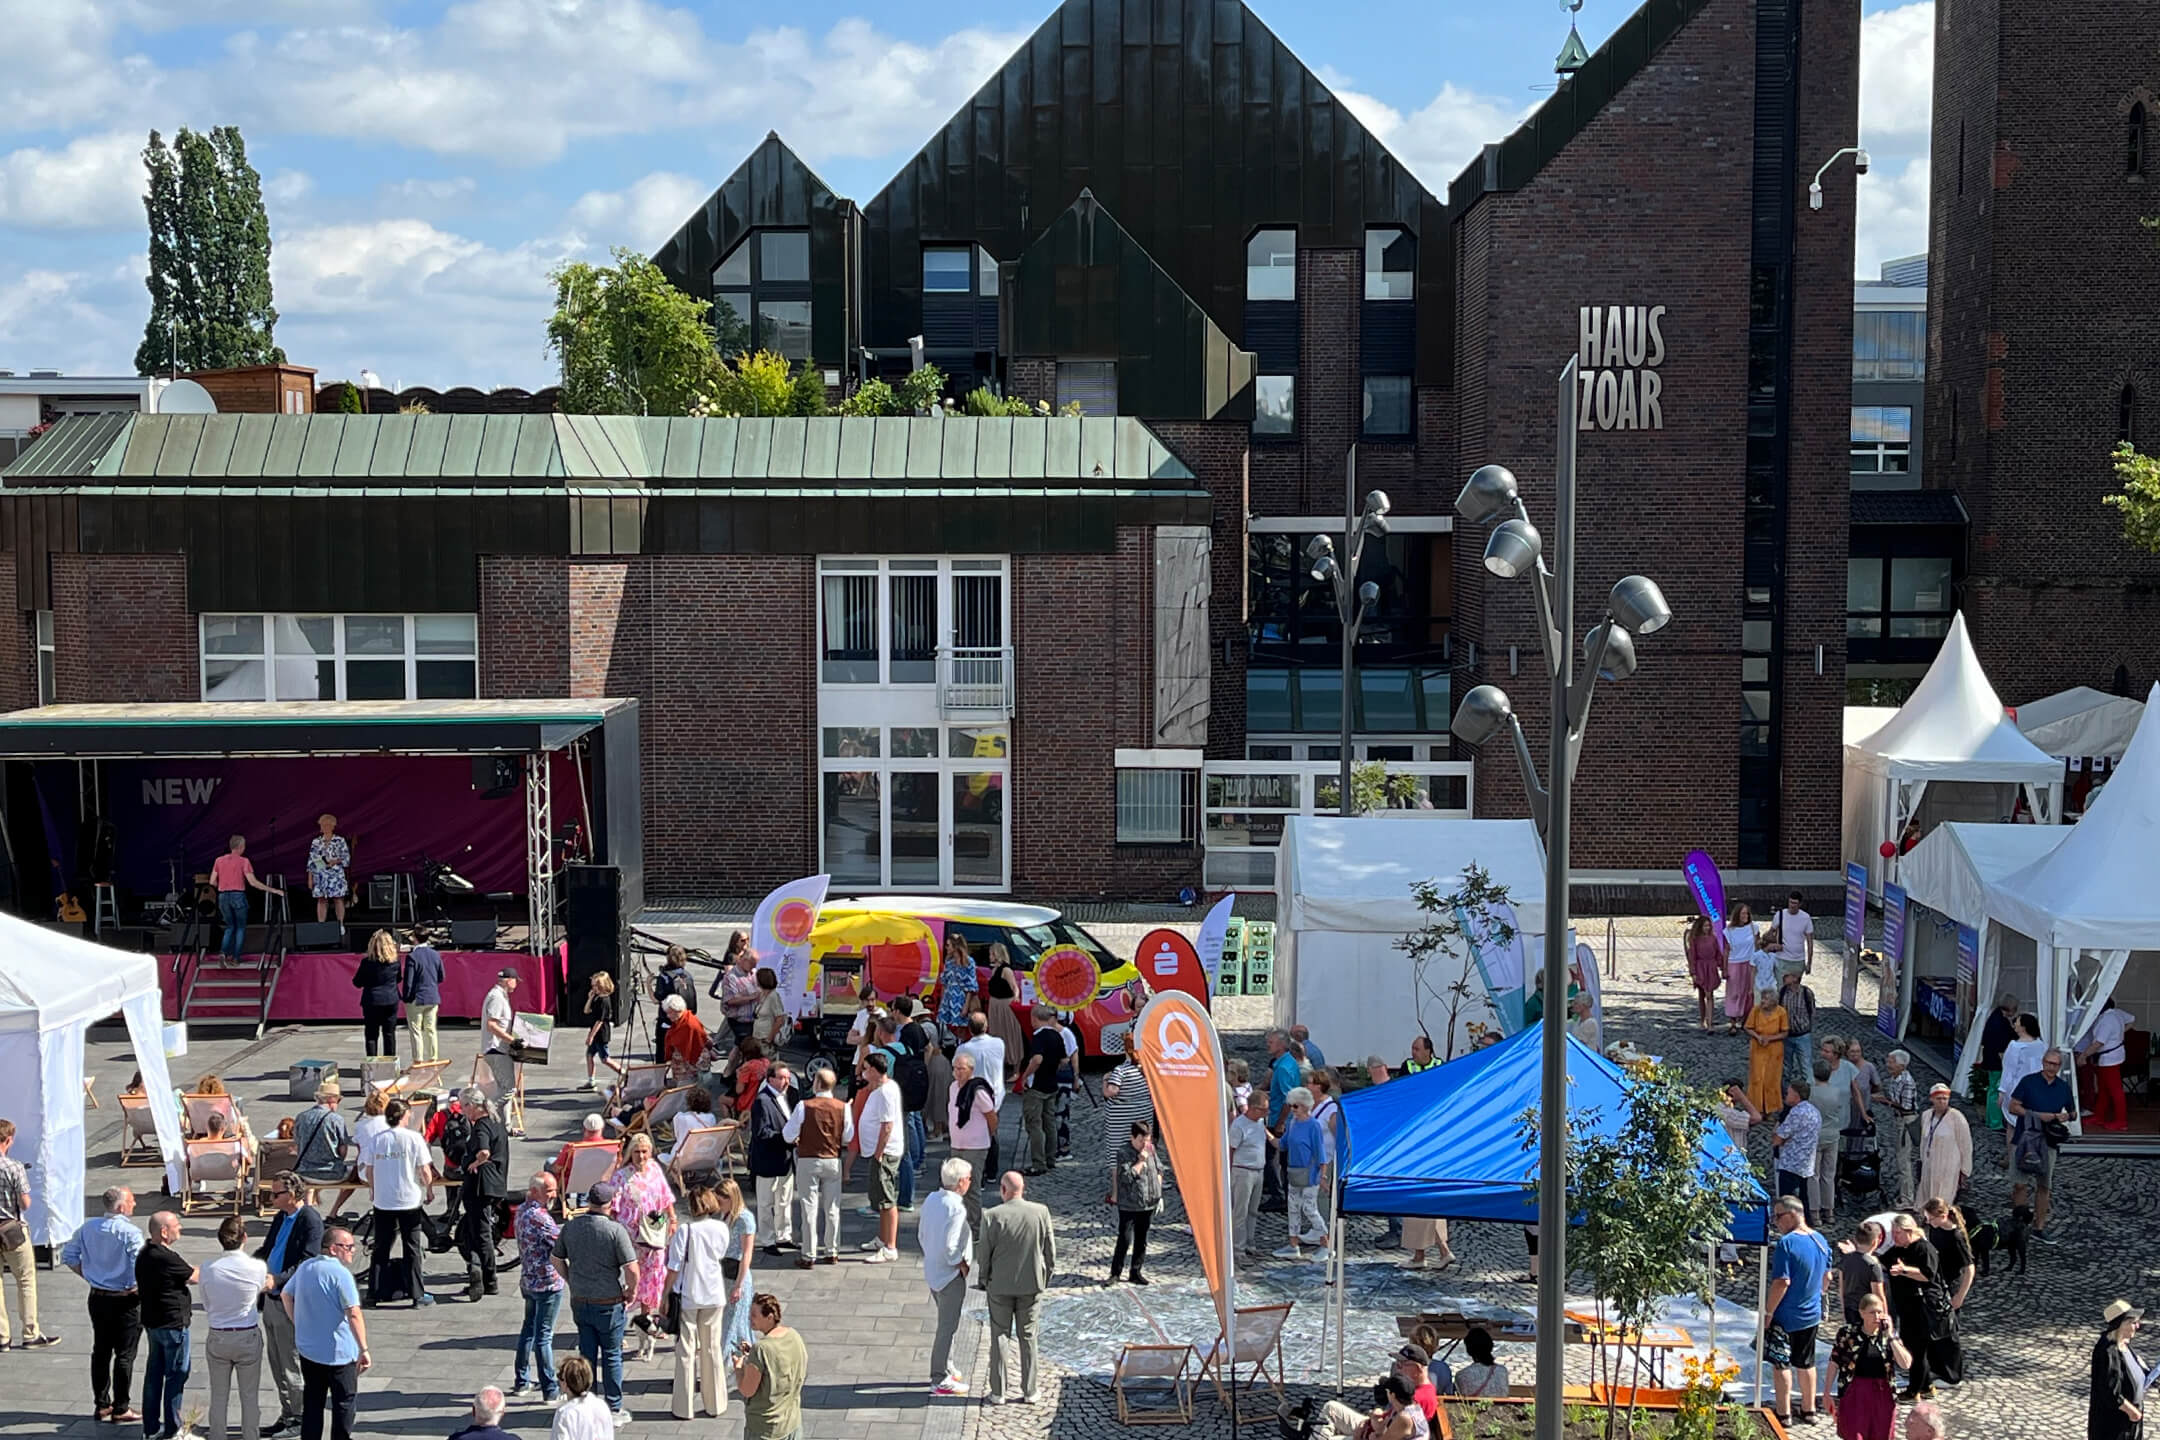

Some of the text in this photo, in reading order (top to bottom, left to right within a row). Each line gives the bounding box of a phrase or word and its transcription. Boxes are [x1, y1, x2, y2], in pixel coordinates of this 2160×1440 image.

[1579, 305, 1665, 368] HAUS
[1578, 369, 1663, 430] ZOAR
[1225, 778, 1280, 798] HAUS ZOAR
